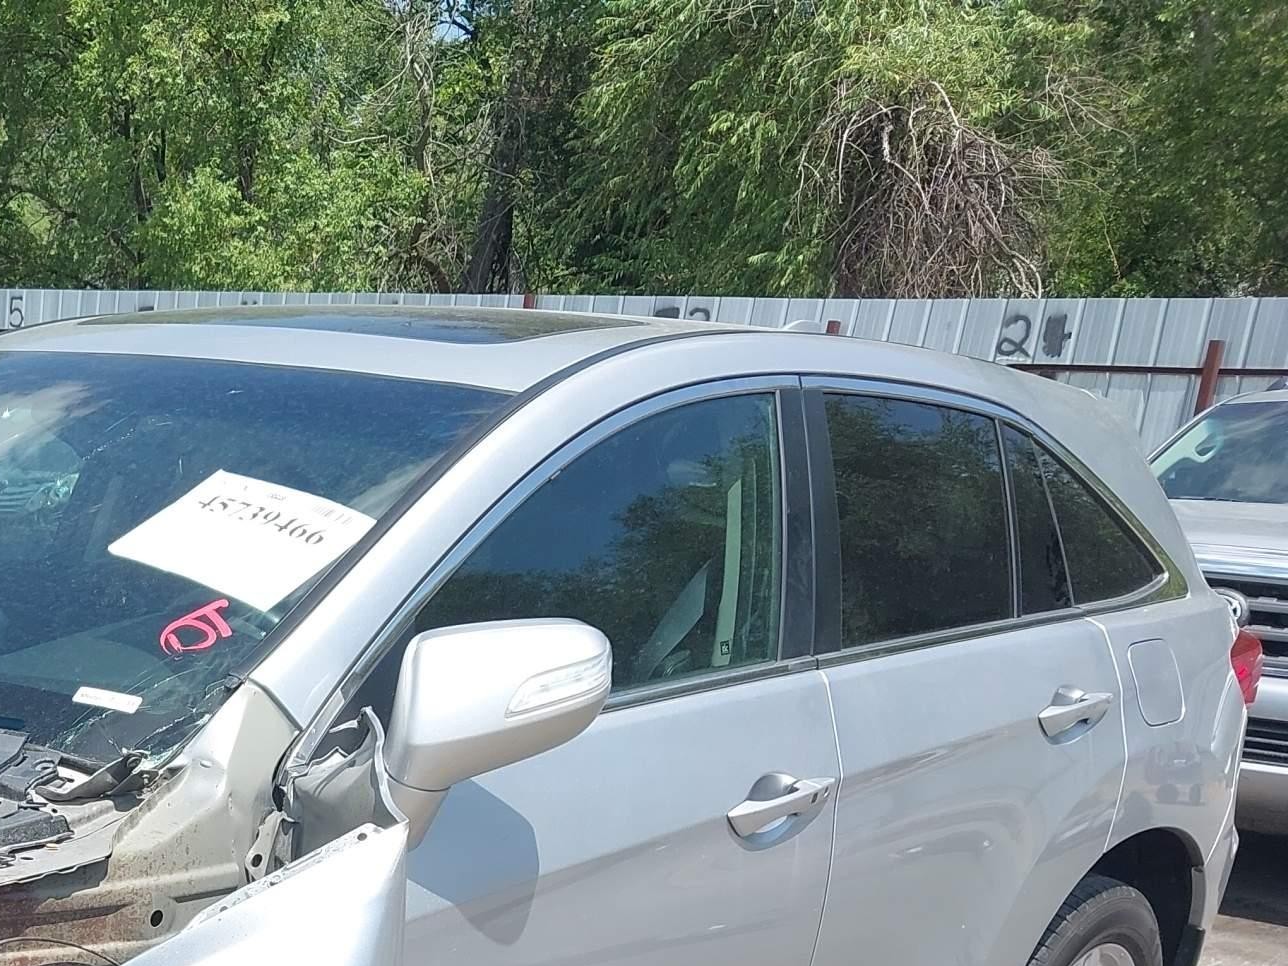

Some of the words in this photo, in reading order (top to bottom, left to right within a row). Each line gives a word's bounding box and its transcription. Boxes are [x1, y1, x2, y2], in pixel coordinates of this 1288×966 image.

[9, 295, 25, 328] 5
[997, 313, 1032, 358] 2
[197, 495, 328, 545] 45739466
